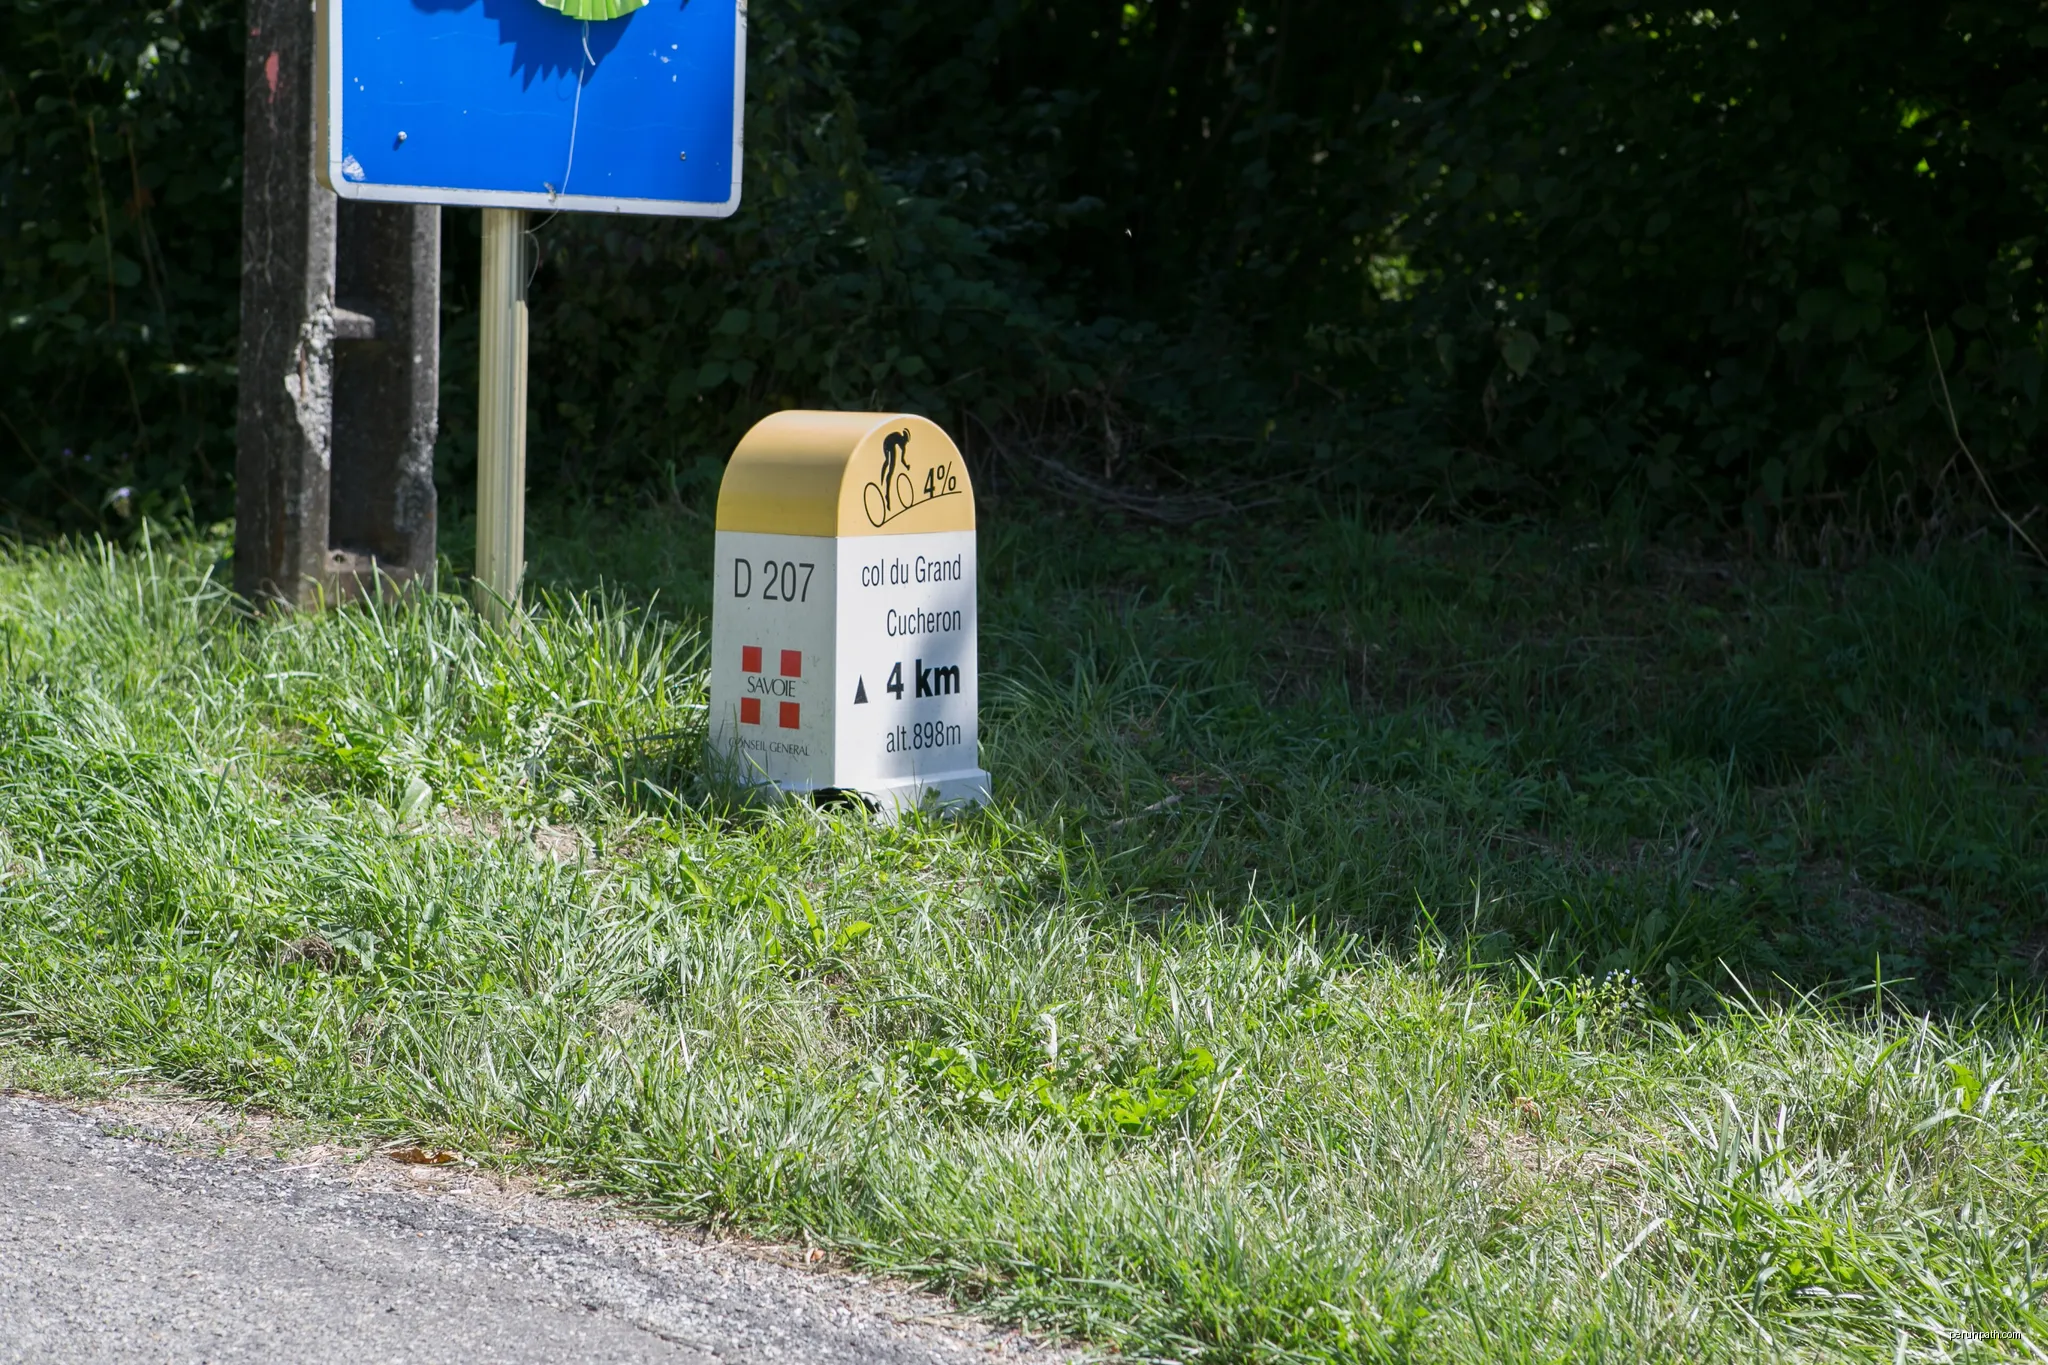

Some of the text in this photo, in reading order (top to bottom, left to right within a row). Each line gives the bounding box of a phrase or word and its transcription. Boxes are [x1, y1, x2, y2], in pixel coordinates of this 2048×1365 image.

[923, 461, 957, 498] 4%
[734, 558, 815, 602] D 207
[861, 553, 961, 587] col du Grand
[886, 607, 962, 637] Cucheron
[747, 675, 796, 698] SAVOIE
[886, 659, 960, 700] 4 km
[769, 741, 810, 757] GENERAL
[886, 720, 961, 753] alt.898m
